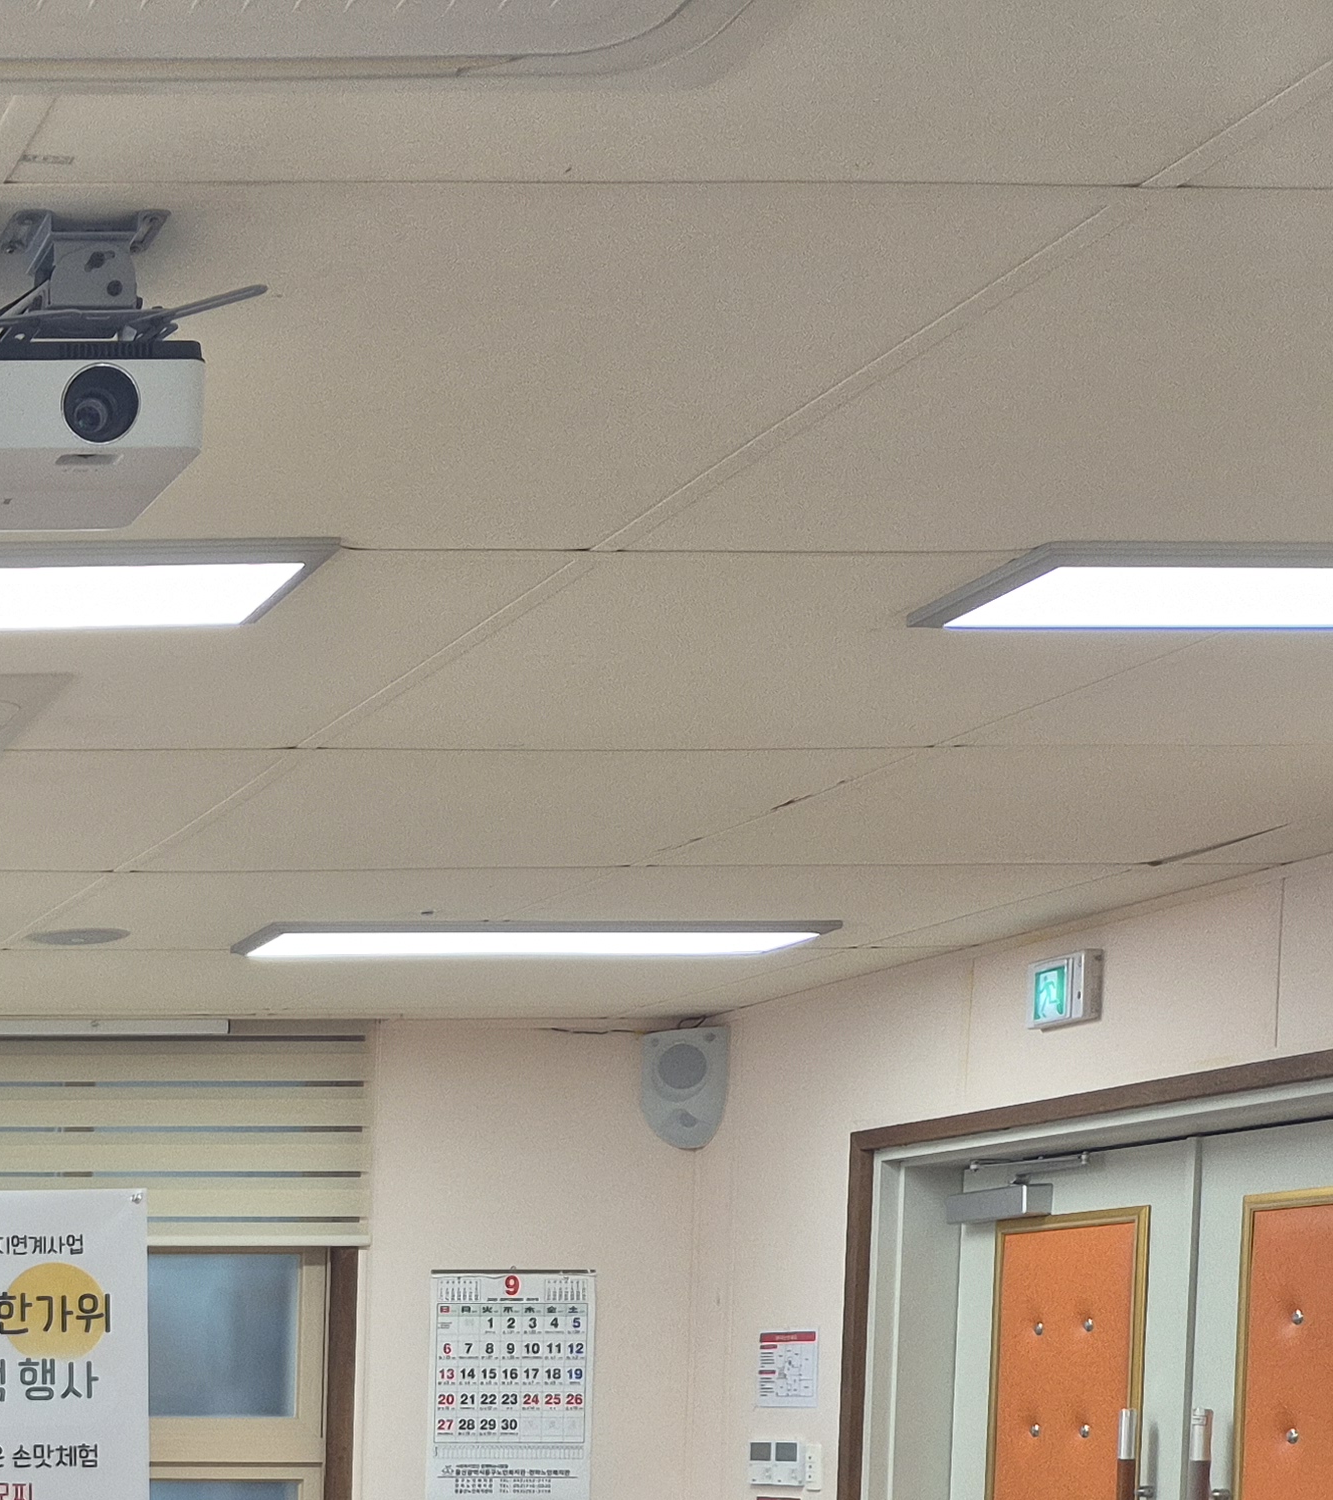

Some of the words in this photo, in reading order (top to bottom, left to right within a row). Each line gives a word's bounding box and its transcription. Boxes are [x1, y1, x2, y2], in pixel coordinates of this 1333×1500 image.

[505, 1275, 520, 1295] 9
[488, 1318, 493, 1328] 1
[507, 1318, 515, 1328] 2
[529, 1318, 537, 1328] 3
[550, 1318, 558, 1328] 4
[573, 1318, 580, 1328] 5
[443, 1343, 451, 1354] 6
[465, 1343, 472, 1354] 7
[486, 1343, 494, 1354] 8
[507, 1343, 515, 1354] 9
[524, 1343, 540, 1354] 10
[547, 1343, 561, 1354] 11
[569, 1343, 583, 1354] 12
[18, 1358, 98, 1400] 행사
[440, 1368, 454, 1379] 13
[461, 1368, 475, 1379] 14
[482, 1368, 496, 1379] 15
[503, 1368, 518, 1379] 16
[524, 1368, 539, 1379] 17
[545, 1368, 561, 1379] 18
[567, 1368, 582, 1379] 19
[438, 1394, 454, 1405] 20
[461, 1394, 475, 1405] 21
[481, 1394, 497, 1405] 22
[502, 1394, 517, 1405] 23
[523, 1394, 539, 1405] 24
[545, 1394, 561, 1405] 25
[566, 1394, 582, 1405] 26
[438, 1419, 453, 1430] 27
[459, 1419, 475, 1430] 28
[480, 1419, 496, 1430] 29
[501, 1419, 517, 1430] 30
[12, 1444, 97, 1468] 손맛체험
